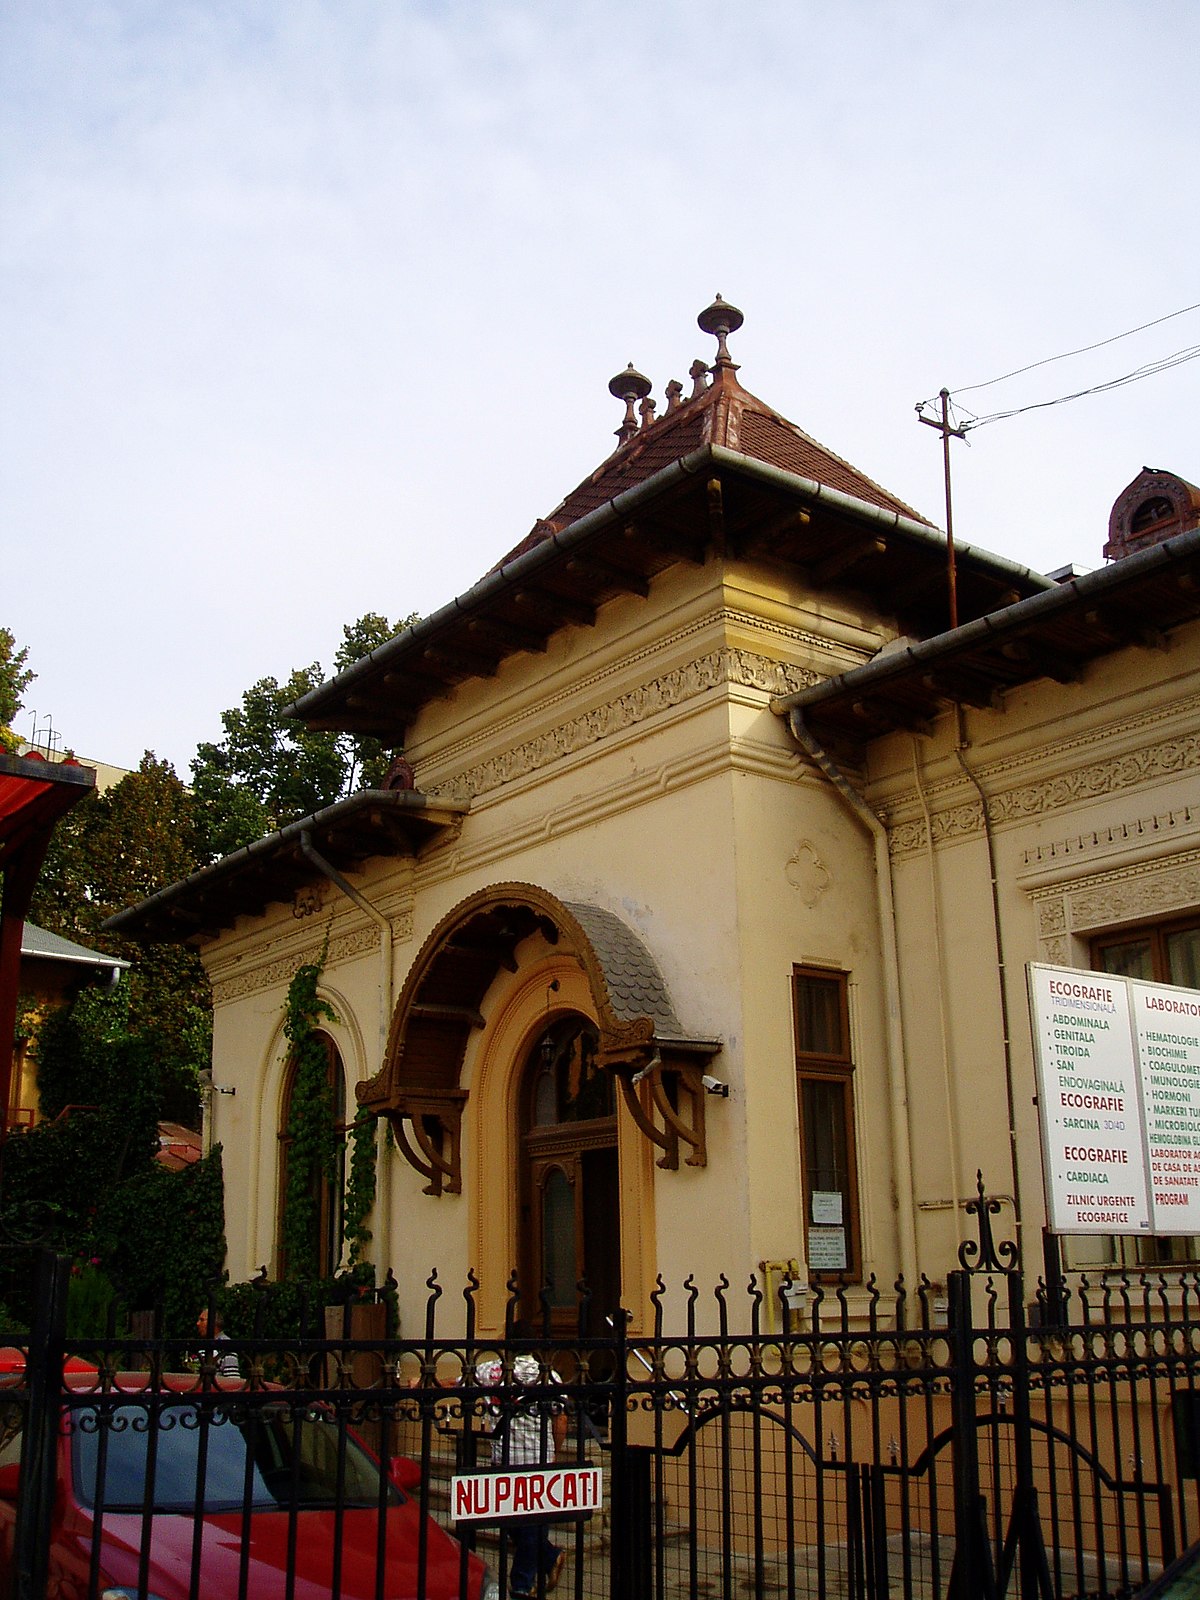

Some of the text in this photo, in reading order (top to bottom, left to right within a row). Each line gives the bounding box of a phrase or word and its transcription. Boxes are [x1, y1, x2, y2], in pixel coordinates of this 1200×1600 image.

[1049, 980, 1112, 1002] ECOGRAFIE
[1052, 1013, 1110, 1030] ABDOMINALA
[1054, 1029, 1095, 1043] GENITALA
[1146, 1031, 1199, 1047] HEMATOLOGIE
[1055, 1044, 1090, 1058] TIROIDA
[1147, 1046, 1187, 1059] BIOCHIMIE
[1056, 1060, 1075, 1071] SAN
[1150, 1075, 1200, 1089] IMUNOLOGIE
[1061, 1093, 1124, 1112] ECOGRAFIE
[1152, 1090, 1191, 1102] HORMONI
[1153, 1105, 1200, 1117] MARKERI TU
[1063, 1118, 1100, 1130] SARCINA
[1064, 1146, 1128, 1164] ECOGRAFIE
[1151, 1149, 1191, 1159] LABORATOR
[1152, 1162, 1161, 1172] DE
[1163, 1163, 1181, 1172] CASA
[1183, 1164, 1192, 1173] DE
[1067, 1171, 1109, 1184] CARDIACA
[1153, 1176, 1198, 1186] DE SANATATE
[1067, 1195, 1136, 1207] ZILNIC URGENTE
[1155, 1193, 1189, 1206] PROGRAM
[1077, 1212, 1128, 1223] ECOGRAFICE
[456, 1472, 598, 1516] NU PARCATI
